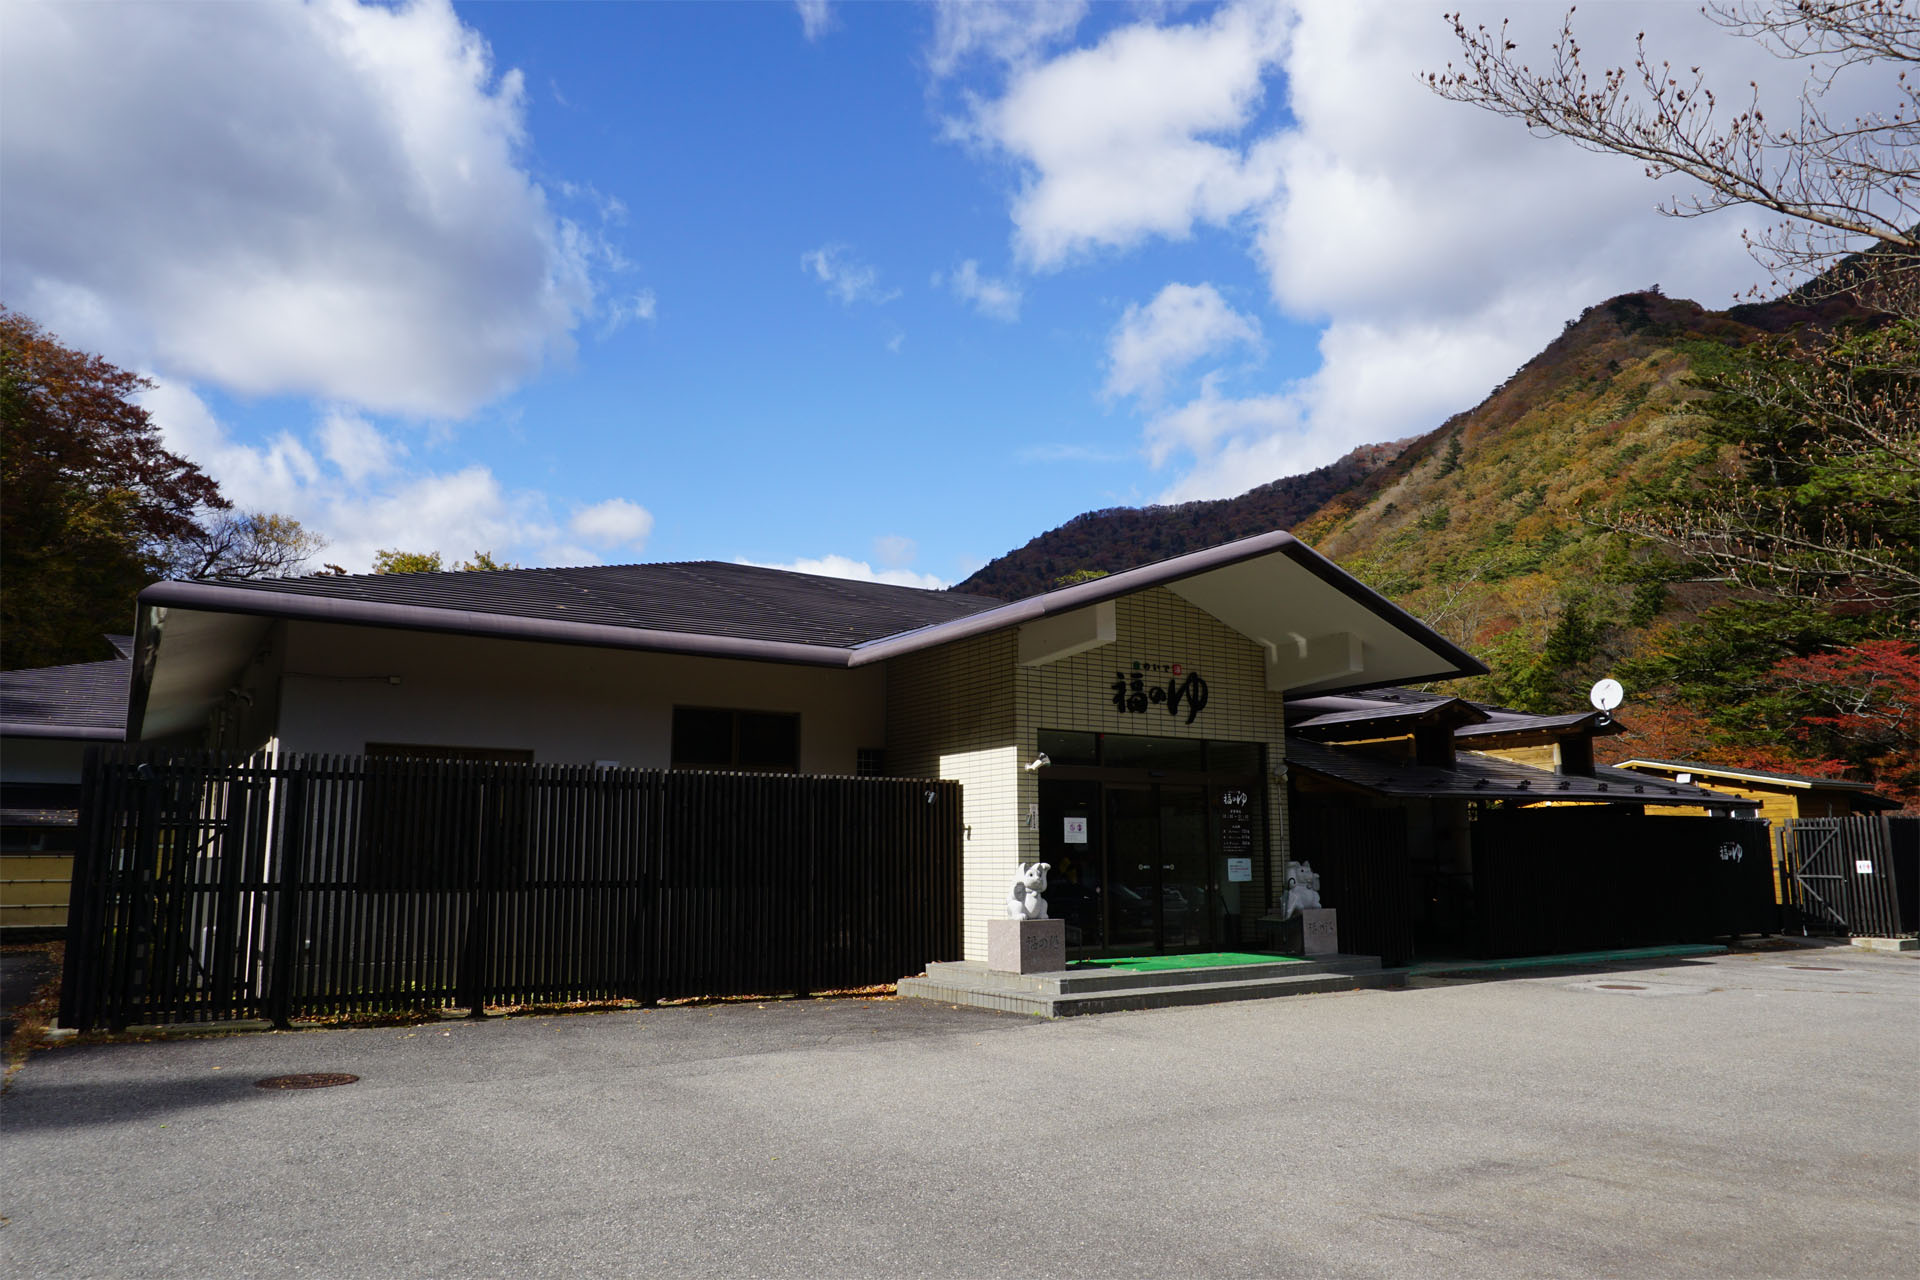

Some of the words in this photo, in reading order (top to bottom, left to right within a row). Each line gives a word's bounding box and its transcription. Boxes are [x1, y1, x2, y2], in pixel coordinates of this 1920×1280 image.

[1111, 672, 1209, 725] 福のゆ
[1719, 843, 1743, 863] 福のゆ
